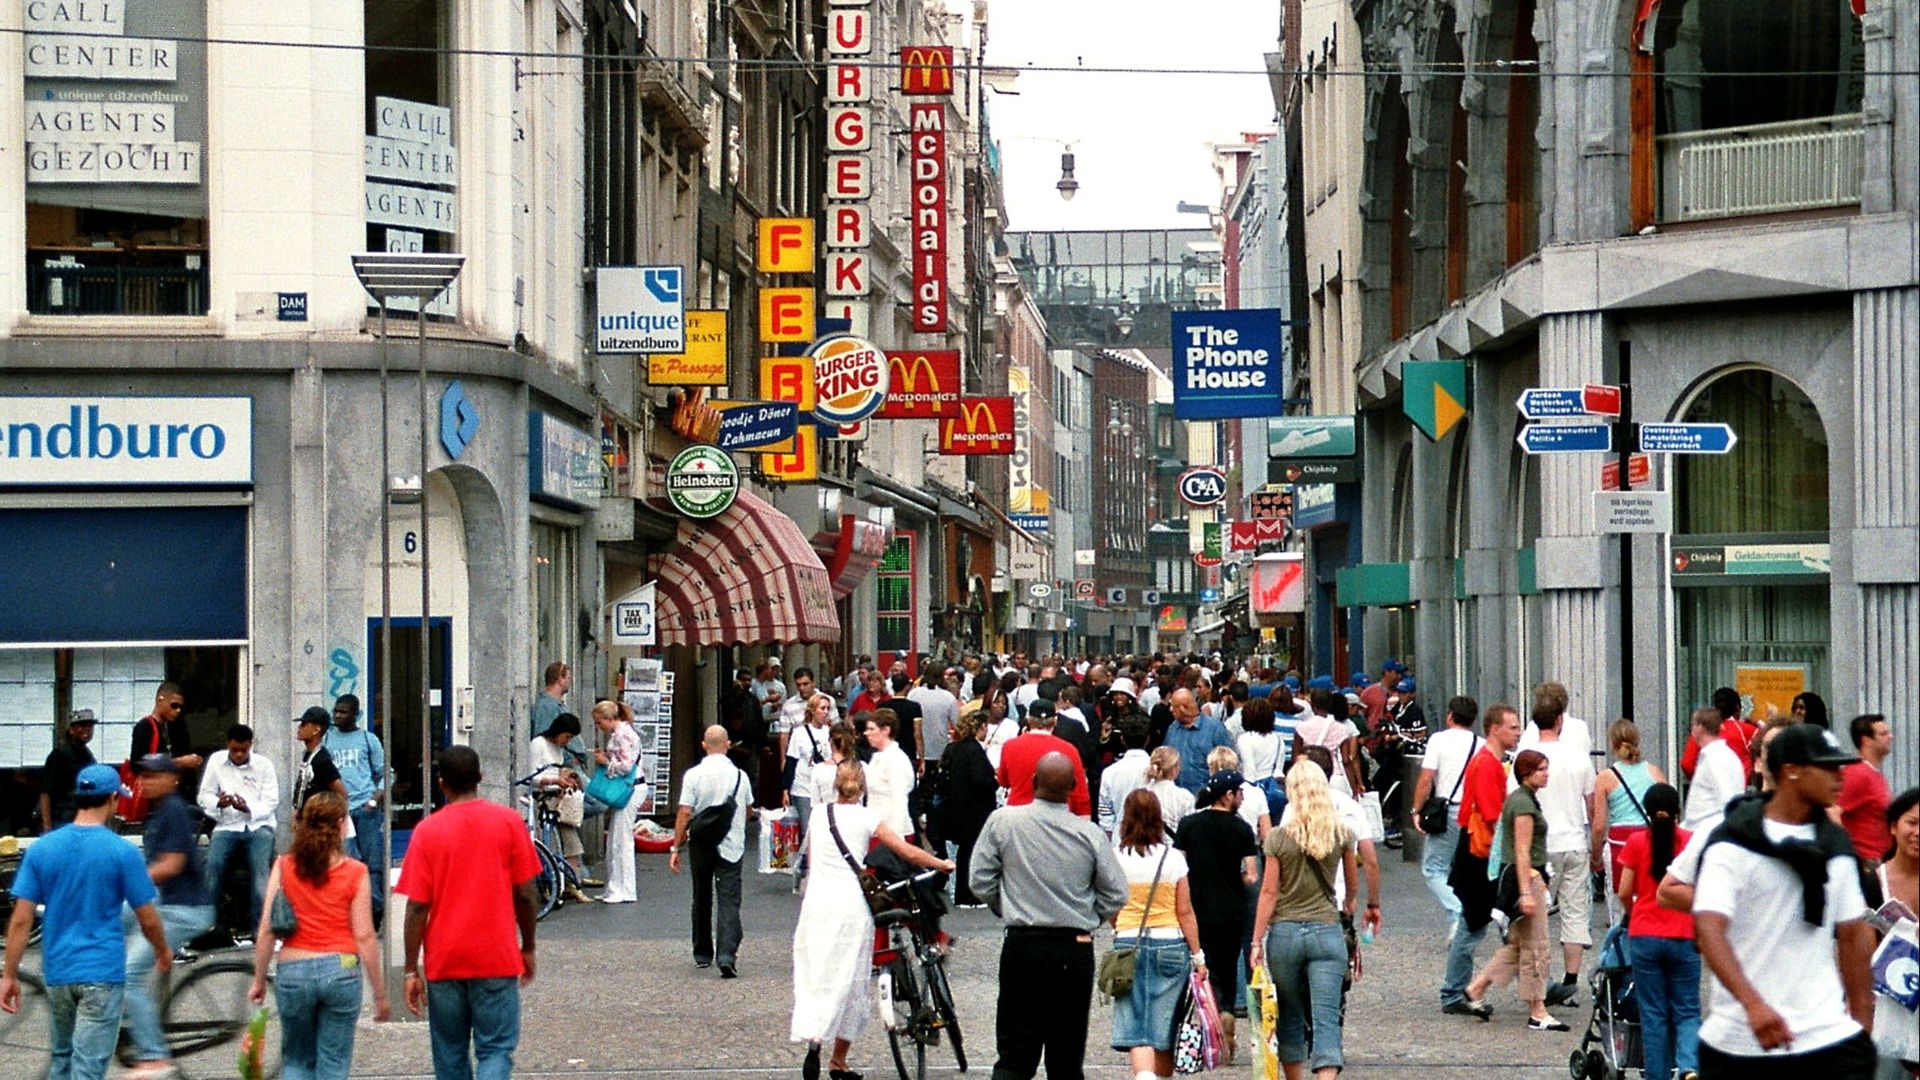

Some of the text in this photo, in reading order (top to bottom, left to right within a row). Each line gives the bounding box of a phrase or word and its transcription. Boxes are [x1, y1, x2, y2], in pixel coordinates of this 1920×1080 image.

[28, 2, 116, 23] CALL
[28, 44, 169, 68] CENTER
[29, 111, 167, 133] AGENTS
[382, 107, 446, 136] CALL
[30, 150, 194, 171] GEZOCHT
[913, 109, 942, 325] McDonalds
[280, 297, 305, 308] DAM
[600, 311, 680, 334] unique
[600, 337, 680, 350] uitzendburo
[1186, 326, 1239, 346] The
[814, 350, 876, 380] BURGER
[1186, 347, 1269, 367] Phone
[667, 358, 726, 379] Passage
[814, 365, 879, 401] KING
[1187, 369, 1267, 389] House
[886, 391, 958, 402] McDonald's
[1529, 391, 1562, 399] Jordaan
[721, 428, 781, 446] Lahmacun
[952, 432, 1013, 442] McDonald's
[1643, 426, 1688, 435] Oosterpark
[1303, 465, 1338, 474] Chipknip
[672, 474, 731, 488] Heineken
[1185, 477, 1222, 497] C&A
[404, 531, 417, 553] 6
[1690, 552, 1723, 563] Chipknip
[1734, 550, 1801, 561] Geldautomaat
[624, 617, 642, 626] FREE
[625, 609, 641, 618] TAX
[303, 640, 314, 655] 6
